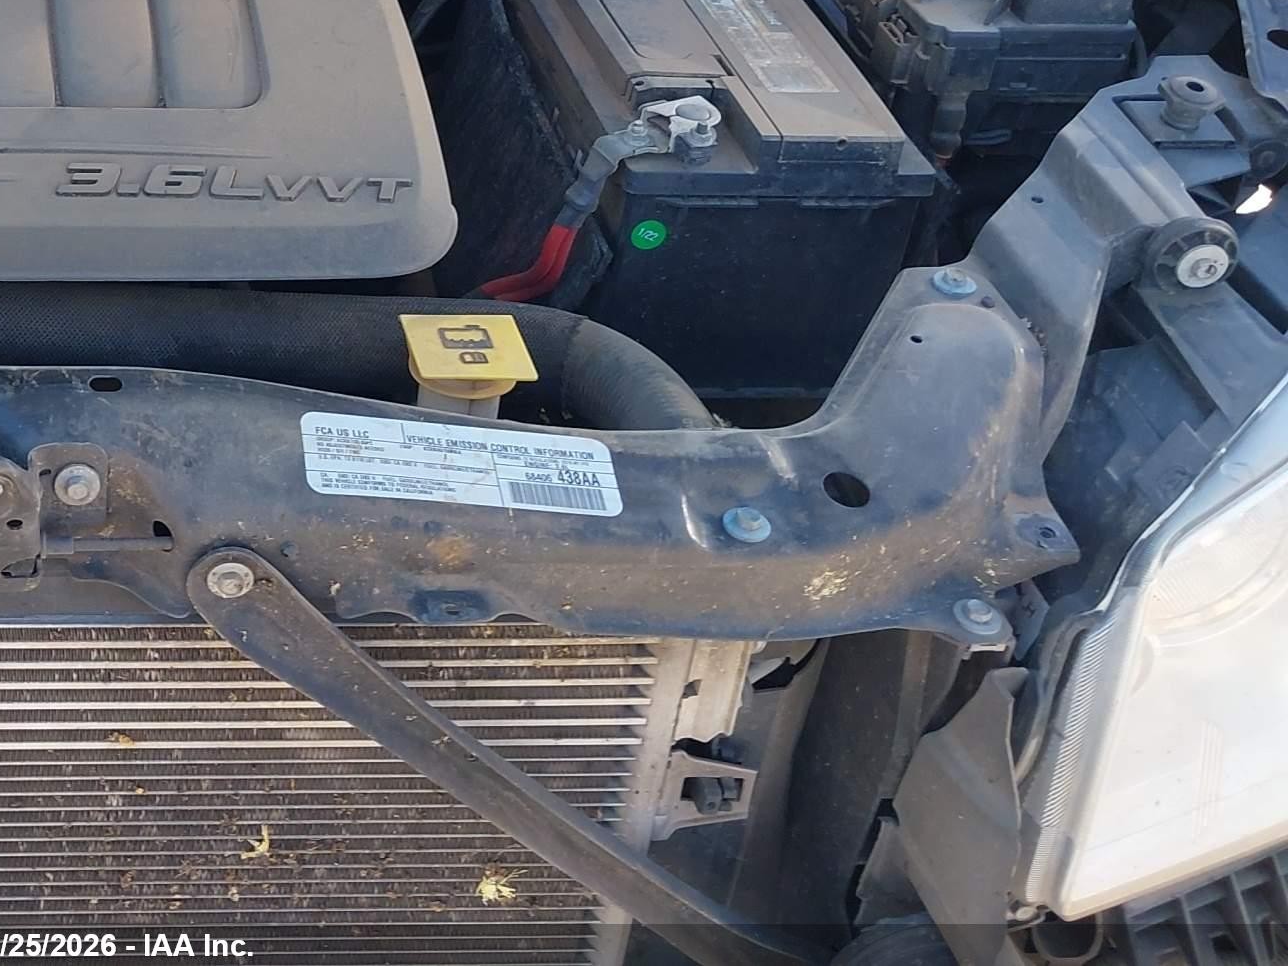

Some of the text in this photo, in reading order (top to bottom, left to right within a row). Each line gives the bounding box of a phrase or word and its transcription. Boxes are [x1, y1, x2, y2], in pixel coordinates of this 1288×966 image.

[315, 426, 369, 439] FCA US LLC
[406, 434, 442, 446] VEHICLE
[446, 439, 488, 451] EMISSION
[490, 442, 529, 455] CONTROL
[533, 446, 595, 461] INFORMATION
[557, 468, 600, 488] 438AA
